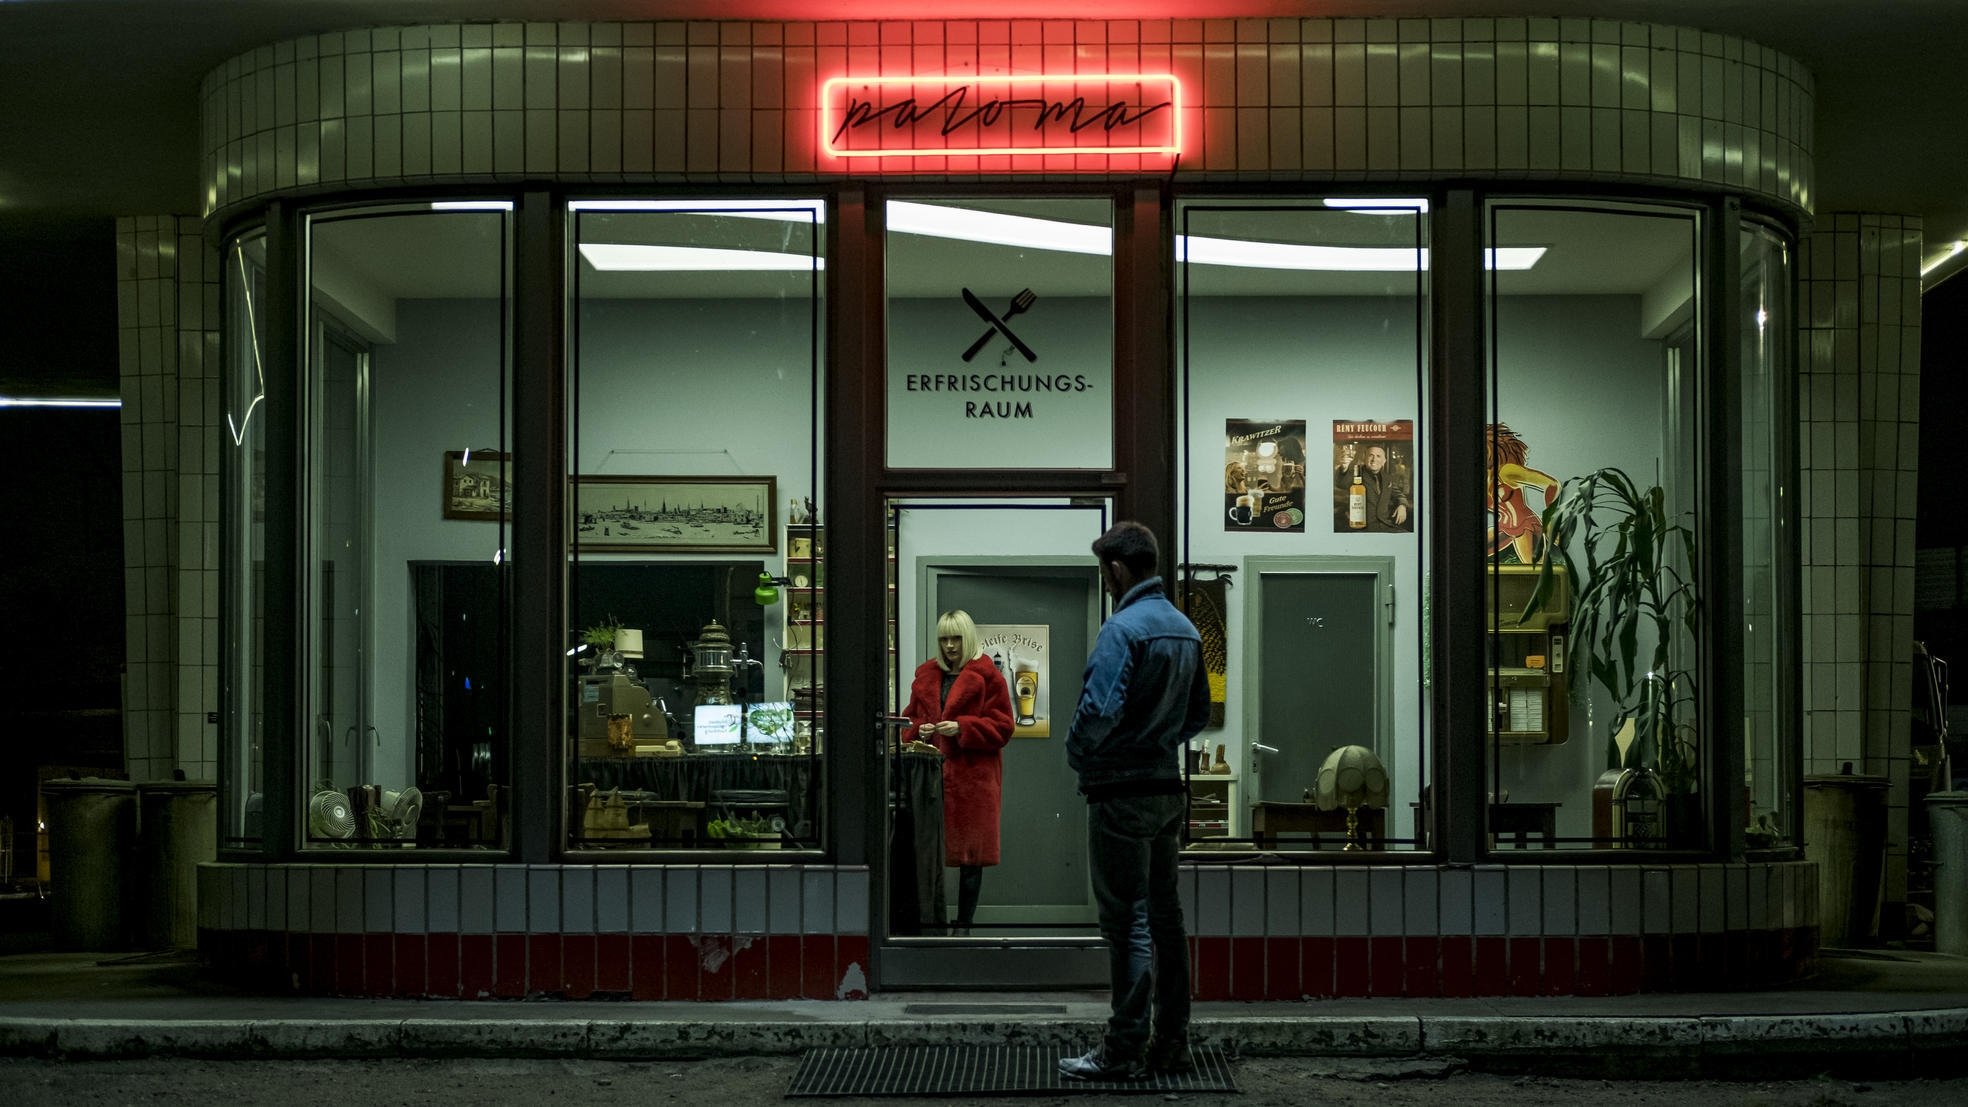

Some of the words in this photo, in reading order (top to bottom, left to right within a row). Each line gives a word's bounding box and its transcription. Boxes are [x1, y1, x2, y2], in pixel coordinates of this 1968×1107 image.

[832, 86, 1171, 144] paloma
[906, 374, 1094, 392] ERFRISCHUNGS-
[965, 401, 1033, 418] RAUM
[1231, 425, 1281, 444] KRAWITZER
[1269, 495, 1287, 504] Gute
